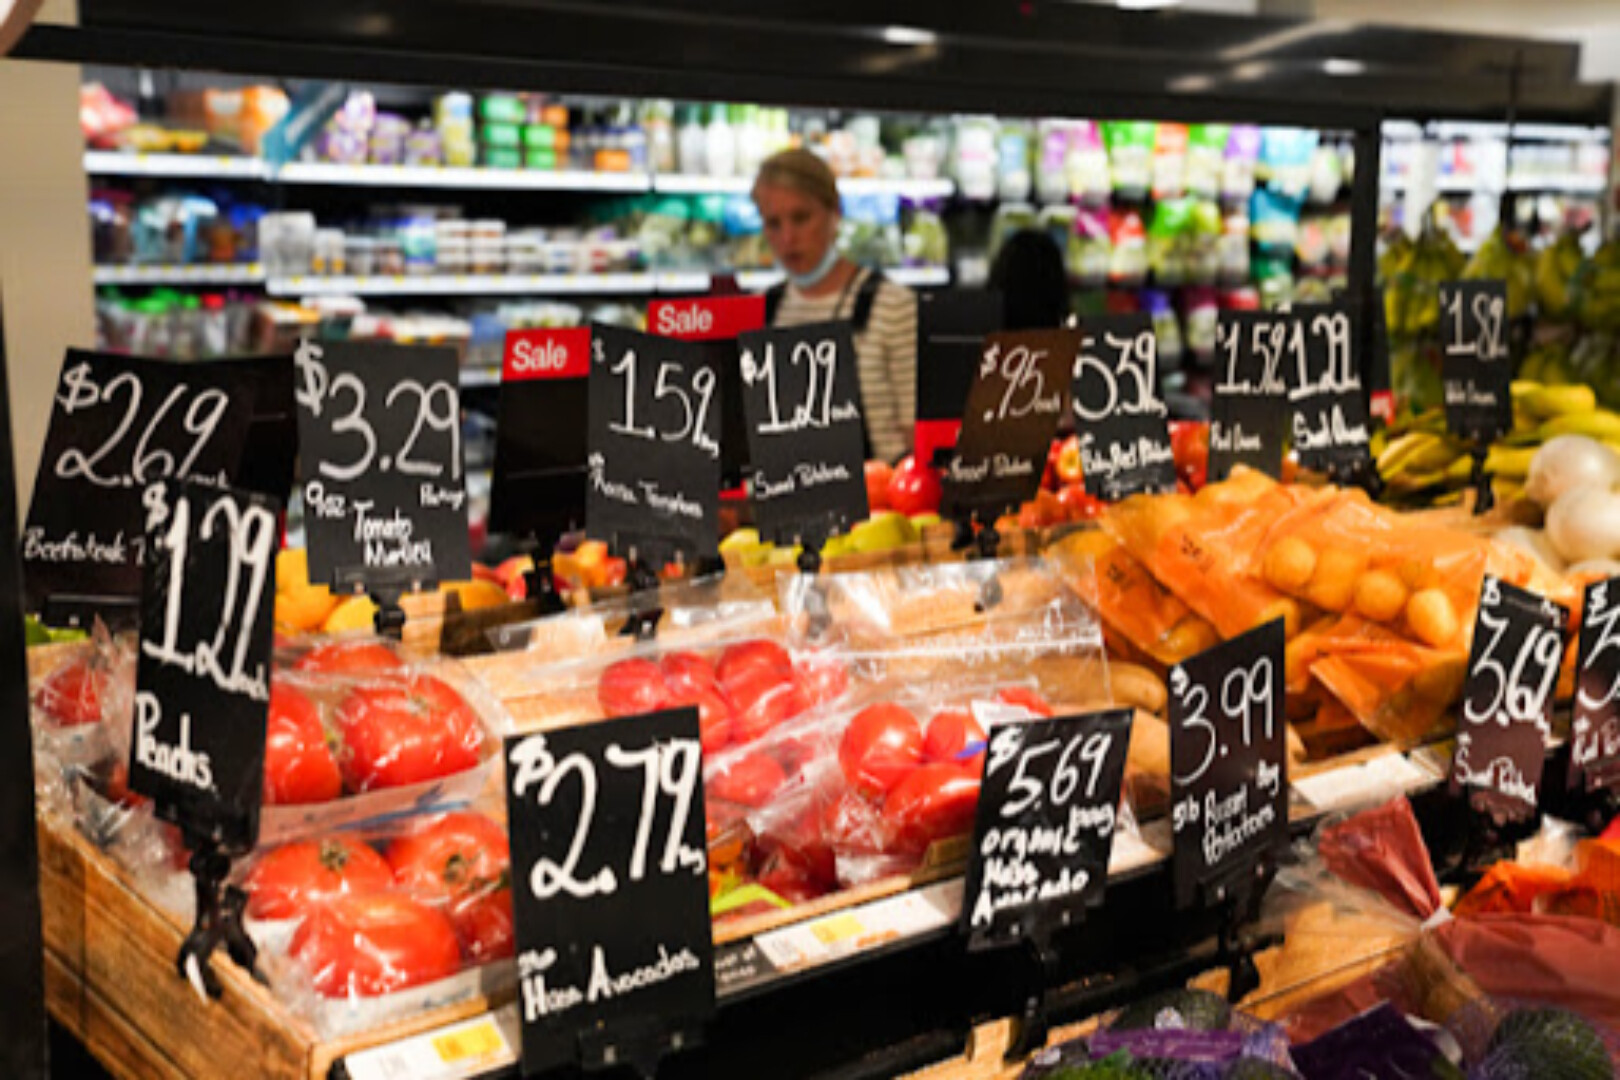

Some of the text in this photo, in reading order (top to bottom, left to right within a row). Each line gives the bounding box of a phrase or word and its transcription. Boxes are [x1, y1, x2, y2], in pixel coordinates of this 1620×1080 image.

[511, 338, 568, 372] Sale
[656, 304, 713, 333] Sale
[56, 362, 229, 486] $2.69
[294, 338, 461, 482] $3.29
[740, 340, 837, 434] $1.29
[141, 481, 276, 691] $1.29
[986, 726, 1113, 818] $5.69
[1170, 656, 1273, 786] $3.99
[508, 734, 701, 899] $2.79
[586, 943, 701, 1002] Avocados
